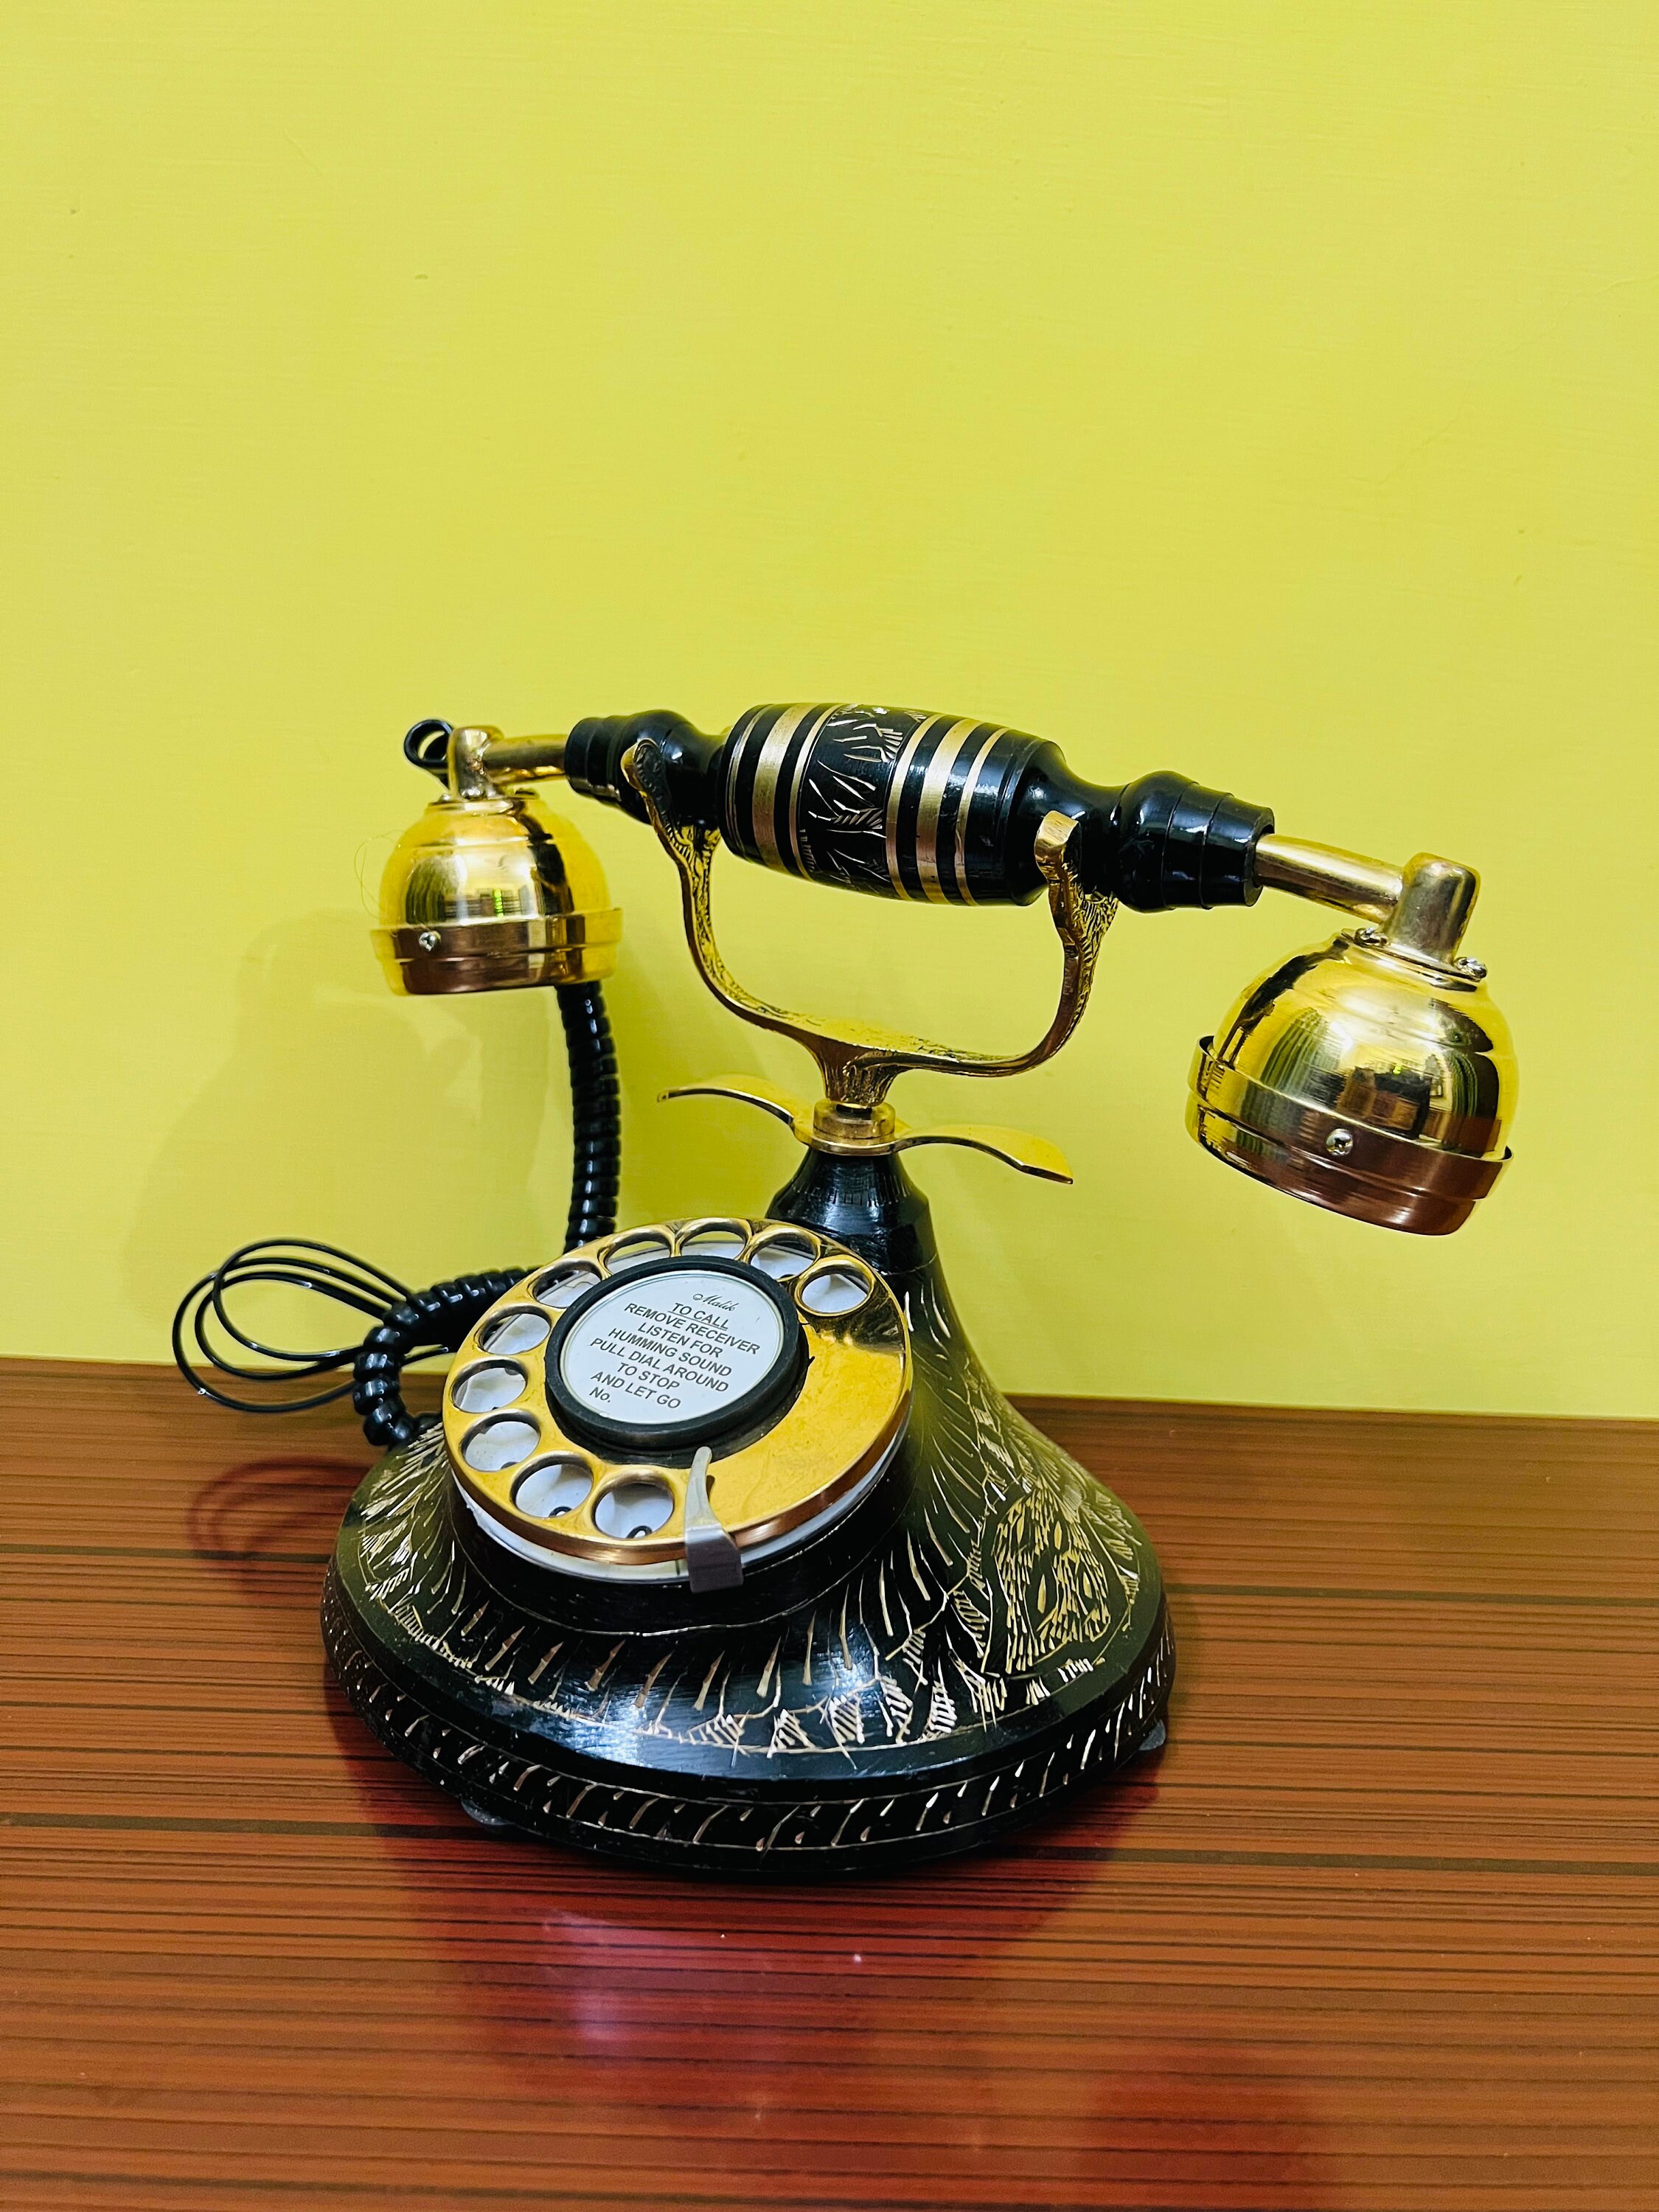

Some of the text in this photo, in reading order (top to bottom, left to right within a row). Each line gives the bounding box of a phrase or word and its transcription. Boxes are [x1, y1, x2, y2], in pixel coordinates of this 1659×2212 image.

[672, 1302, 728, 1329] TO CALL
[692, 1293, 740, 1311] Malik
[625, 1303, 760, 1354] REMOVE RECEIVER
[638, 1322, 723, 1357] LISTEN FOR
[590, 1338, 728, 1392] PULL DIAL AROUND
[608, 1328, 731, 1377] HUMMING SOUND
[591, 1371, 681, 1409] AND LET GO
[618, 1362, 680, 1390] TO STOP
[589, 1386, 611, 1403] No.
